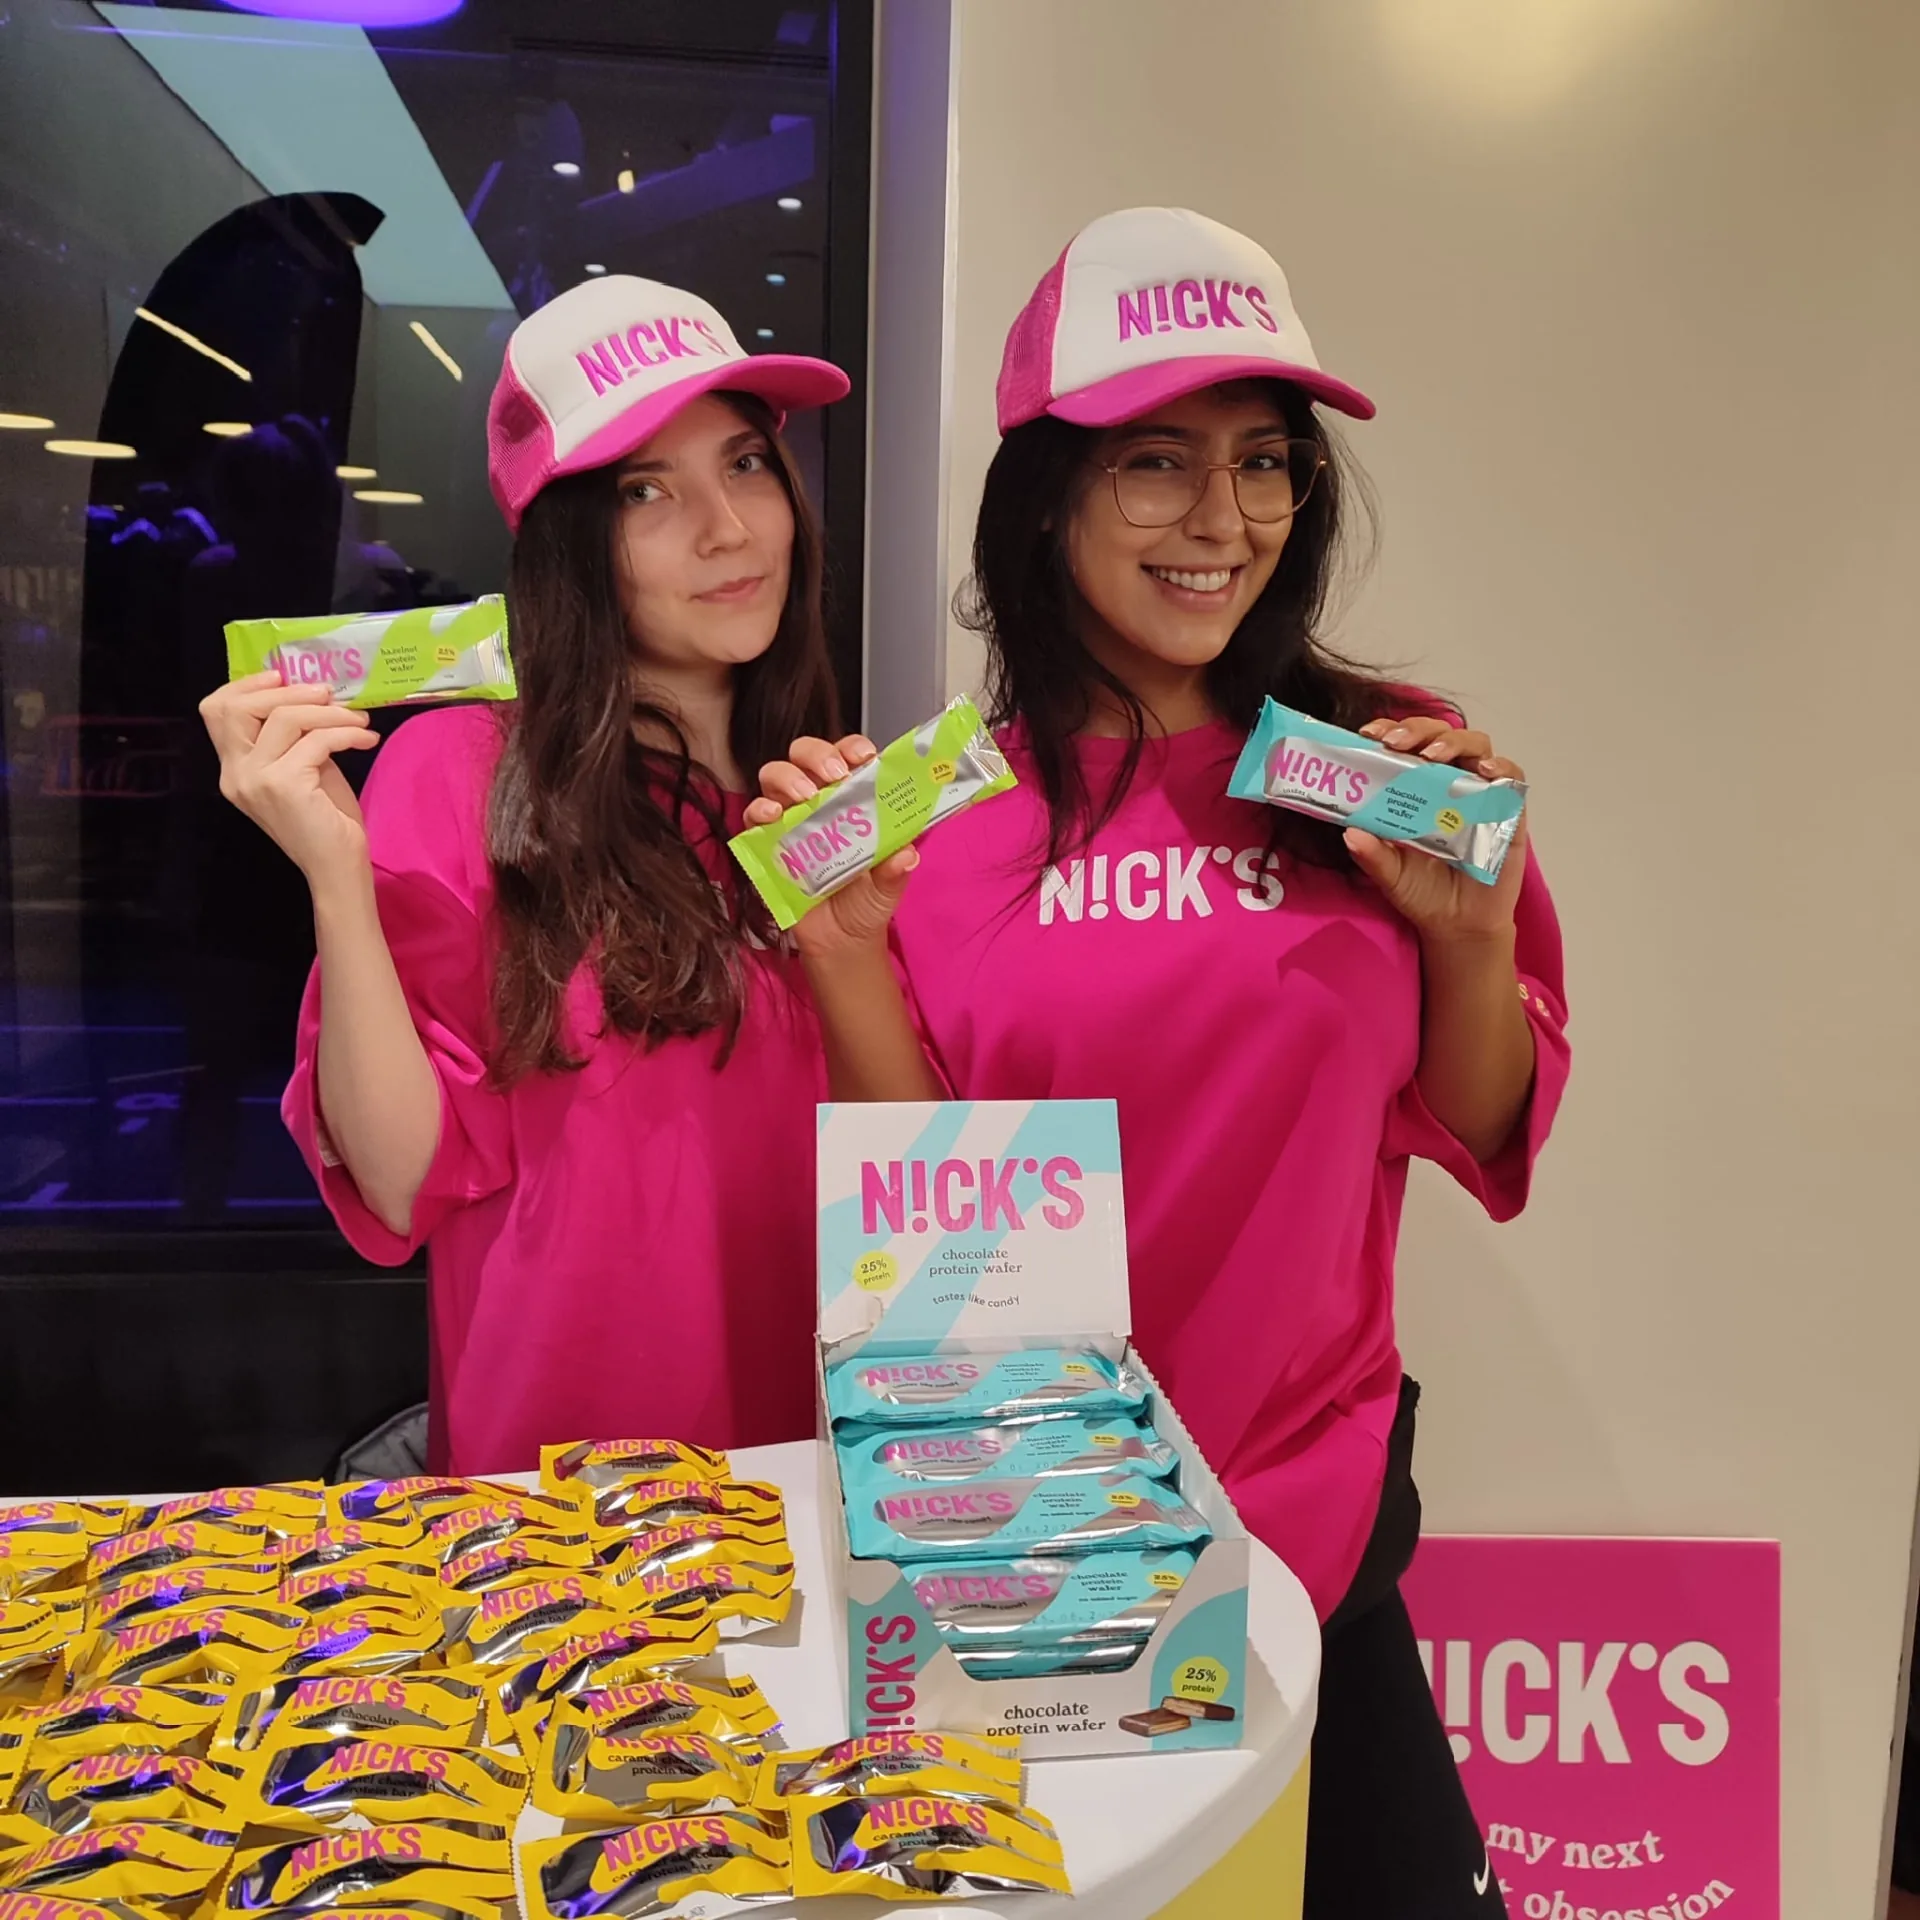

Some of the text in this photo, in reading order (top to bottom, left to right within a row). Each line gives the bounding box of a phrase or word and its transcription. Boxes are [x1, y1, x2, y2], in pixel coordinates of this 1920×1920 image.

[879, 776, 914, 801] hazelnut
[1385, 786, 1428, 805] chocolate
[888, 787, 917, 809] protein
[1387, 797, 1420, 812] protein
[1387, 807, 1415, 821] wafer
[942, 1248, 1009, 1261] chocolate
[860, 1258, 887, 1274] 25%
[929, 1261, 1023, 1278] protein wafer
[863, 1271, 891, 1285] protein
[932, 1292, 1020, 1309] tastes like candy
[1070, 1571, 1129, 1581] chocolate
[865, 1614, 917, 1737] !CK'S
[1184, 1667, 1217, 1682] 25%
[1182, 1682, 1215, 1694] protein
[341, 1706, 400, 1726] chocolate
[667, 1711, 690, 1720] bar
[1004, 1702, 1089, 1720] chocolate
[987, 1719, 1106, 1738] protein wafer
[631, 1766, 678, 1778] protein
[900, 1761, 923, 1770] bar
[873, 1829, 928, 1842] caramel
[1485, 1822, 1665, 1870] my next
